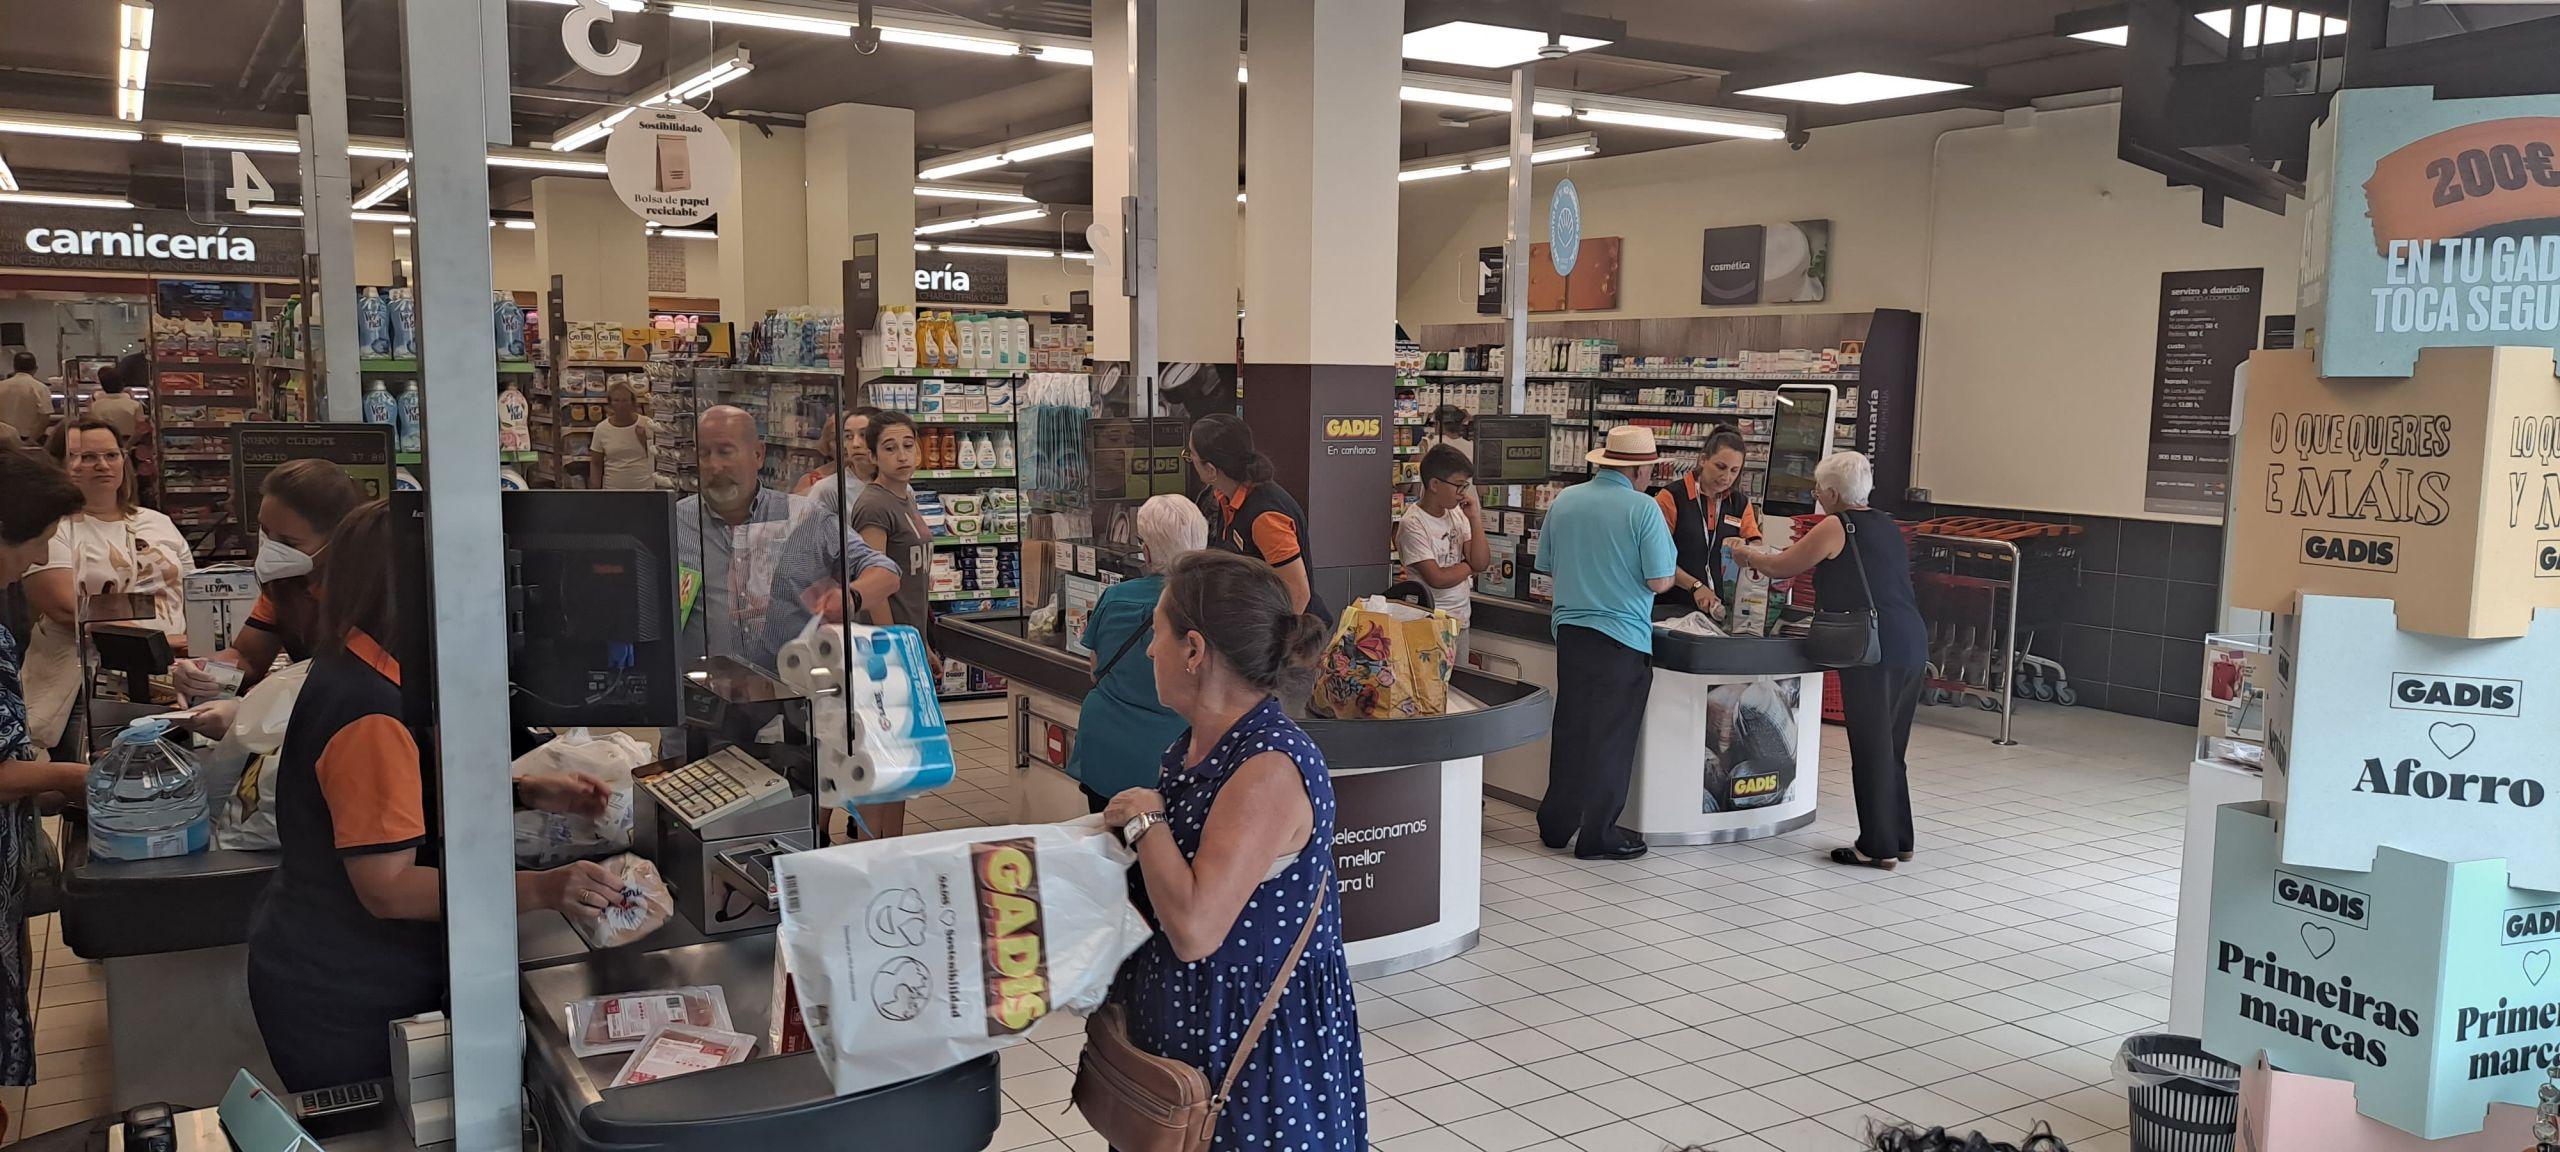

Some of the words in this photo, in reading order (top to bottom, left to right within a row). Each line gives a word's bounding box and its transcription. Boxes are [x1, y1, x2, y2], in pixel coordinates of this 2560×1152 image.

[639, 121, 702, 133] Sostibilidade
[2425, 142, 2560, 209] 200€
[634, 194, 663, 204] Bolsa
[665, 194, 678, 205] de
[680, 196, 709, 208] papel
[646, 206, 698, 217] reciclable
[25, 222, 256, 262] carnicería
[915, 263, 970, 291] ería
[1710, 260, 1751, 272] cosmética
[2386, 239, 2433, 285] EN
[2439, 237, 2485, 284] TU
[2171, 287, 2200, 296] servizo
[2210, 285, 2250, 294] domicilio
[2169, 309, 2189, 317] gratis
[2371, 286, 2459, 333] TOCA
[2466, 284, 2560, 332] SEGU
[1326, 418, 1380, 438] GADIS
[2270, 412, 2288, 454] O
[2295, 413, 2345, 461] QUE
[2348, 414, 2451, 462] QUERES
[2510, 416, 2537, 459] LO
[1327, 445, 1339, 455] En
[1341, 445, 1377, 455] confianza
[2265, 463, 2285, 513] E
[2290, 458, 2451, 525] MÁIS
[2509, 472, 2527, 528] Y
[2305, 535, 2394, 566] GADIS
[2396, 678, 2515, 710] GADIS
[1734, 775, 1777, 796] GADIS
[2352, 757, 2545, 808] Aforro
[1339, 849, 1387, 869] mellor
[1337, 876, 1362, 893] ara
[1365, 873, 1375, 889] ti
[2278, 877, 2366, 921] GADIS
[980, 846, 1050, 1031] GADIS
[2217, 940, 2421, 1038] Primeiras
[2239, 991, 2389, 1068] marcas
